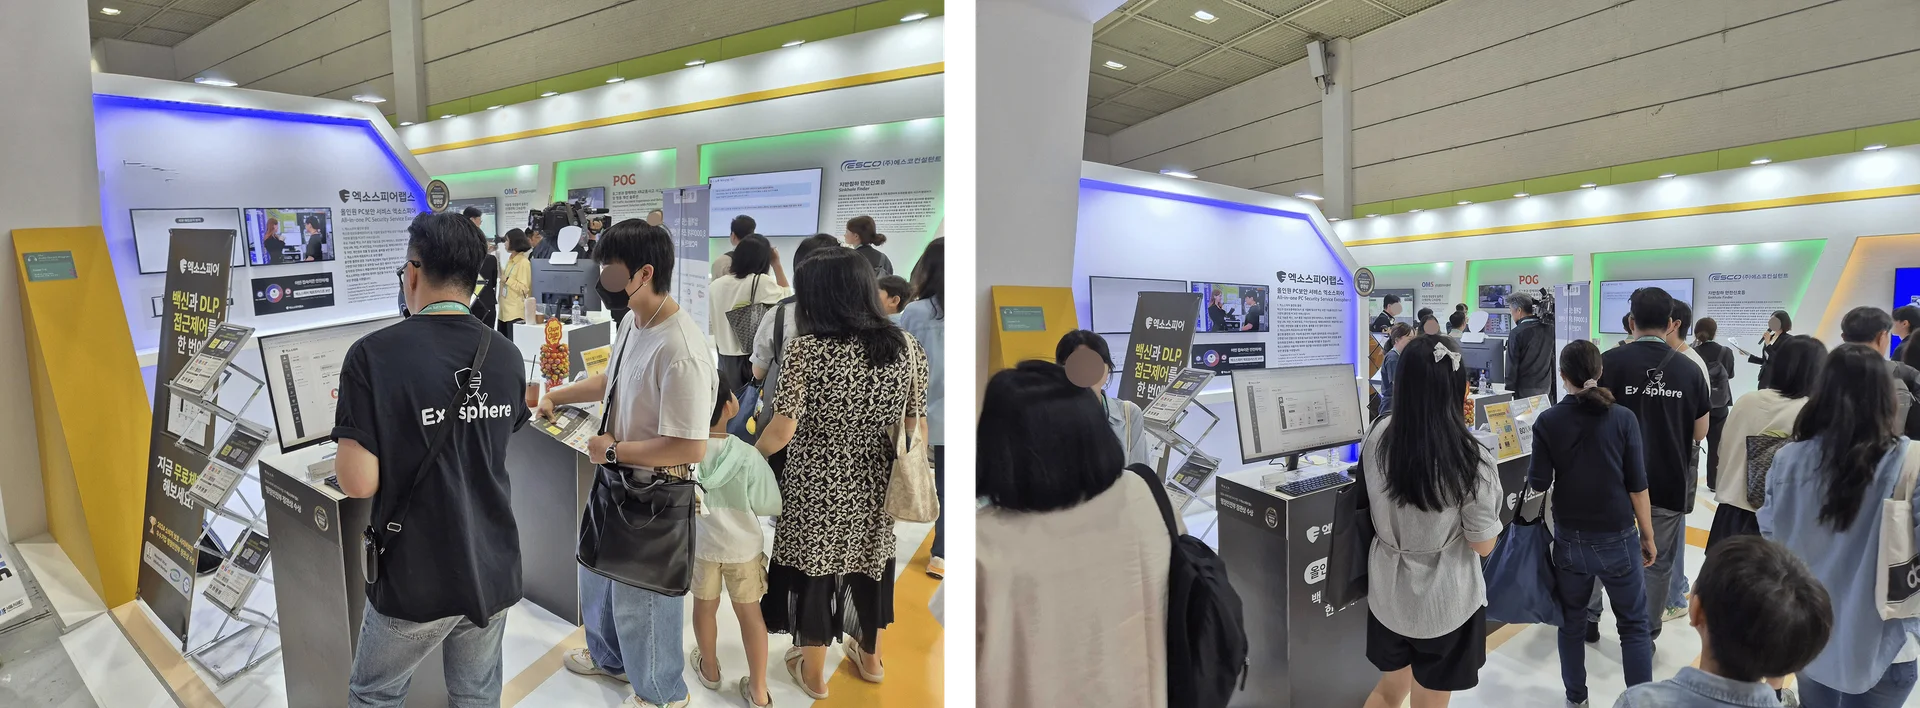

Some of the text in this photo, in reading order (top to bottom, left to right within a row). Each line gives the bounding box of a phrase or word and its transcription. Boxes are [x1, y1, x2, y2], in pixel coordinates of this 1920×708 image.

[841, 156, 941, 171] ESCO (주)에스코컨설턴트
[613, 173, 636, 186] POG
[352, 190, 415, 203] 엑소스피어랩스
[341, 208, 357, 216] 올인원
[392, 207, 417, 215] 엑소스피어
[187, 261, 220, 276] 엑소스피어
[1288, 272, 1344, 286] 엑소스피어랩스
[1519, 274, 1539, 285] POG
[1708, 273, 1741, 282] ESCO
[1277, 287, 1291, 295] 올인원
[1292, 288, 1308, 296] PC보안
[172, 290, 221, 319] 백신과 DLP,
[173, 312, 217, 338] 접근제어를
[1153, 318, 1185, 332] 엑소스피어
[177, 335, 187, 355] 한
[1135, 343, 1183, 366] 백신과 DLP,
[1134, 362, 1178, 383] 접근제어를
[1136, 382, 1146, 398] 한
[1625, 385, 1683, 399] Exsphere
[421, 404, 512, 426] Exsphere
[157, 456, 201, 486] 지금 무료체
[163, 479, 194, 510] 해보세요!
[1321, 523, 1333, 535] 엑
[1311, 590, 1321, 604] 백
